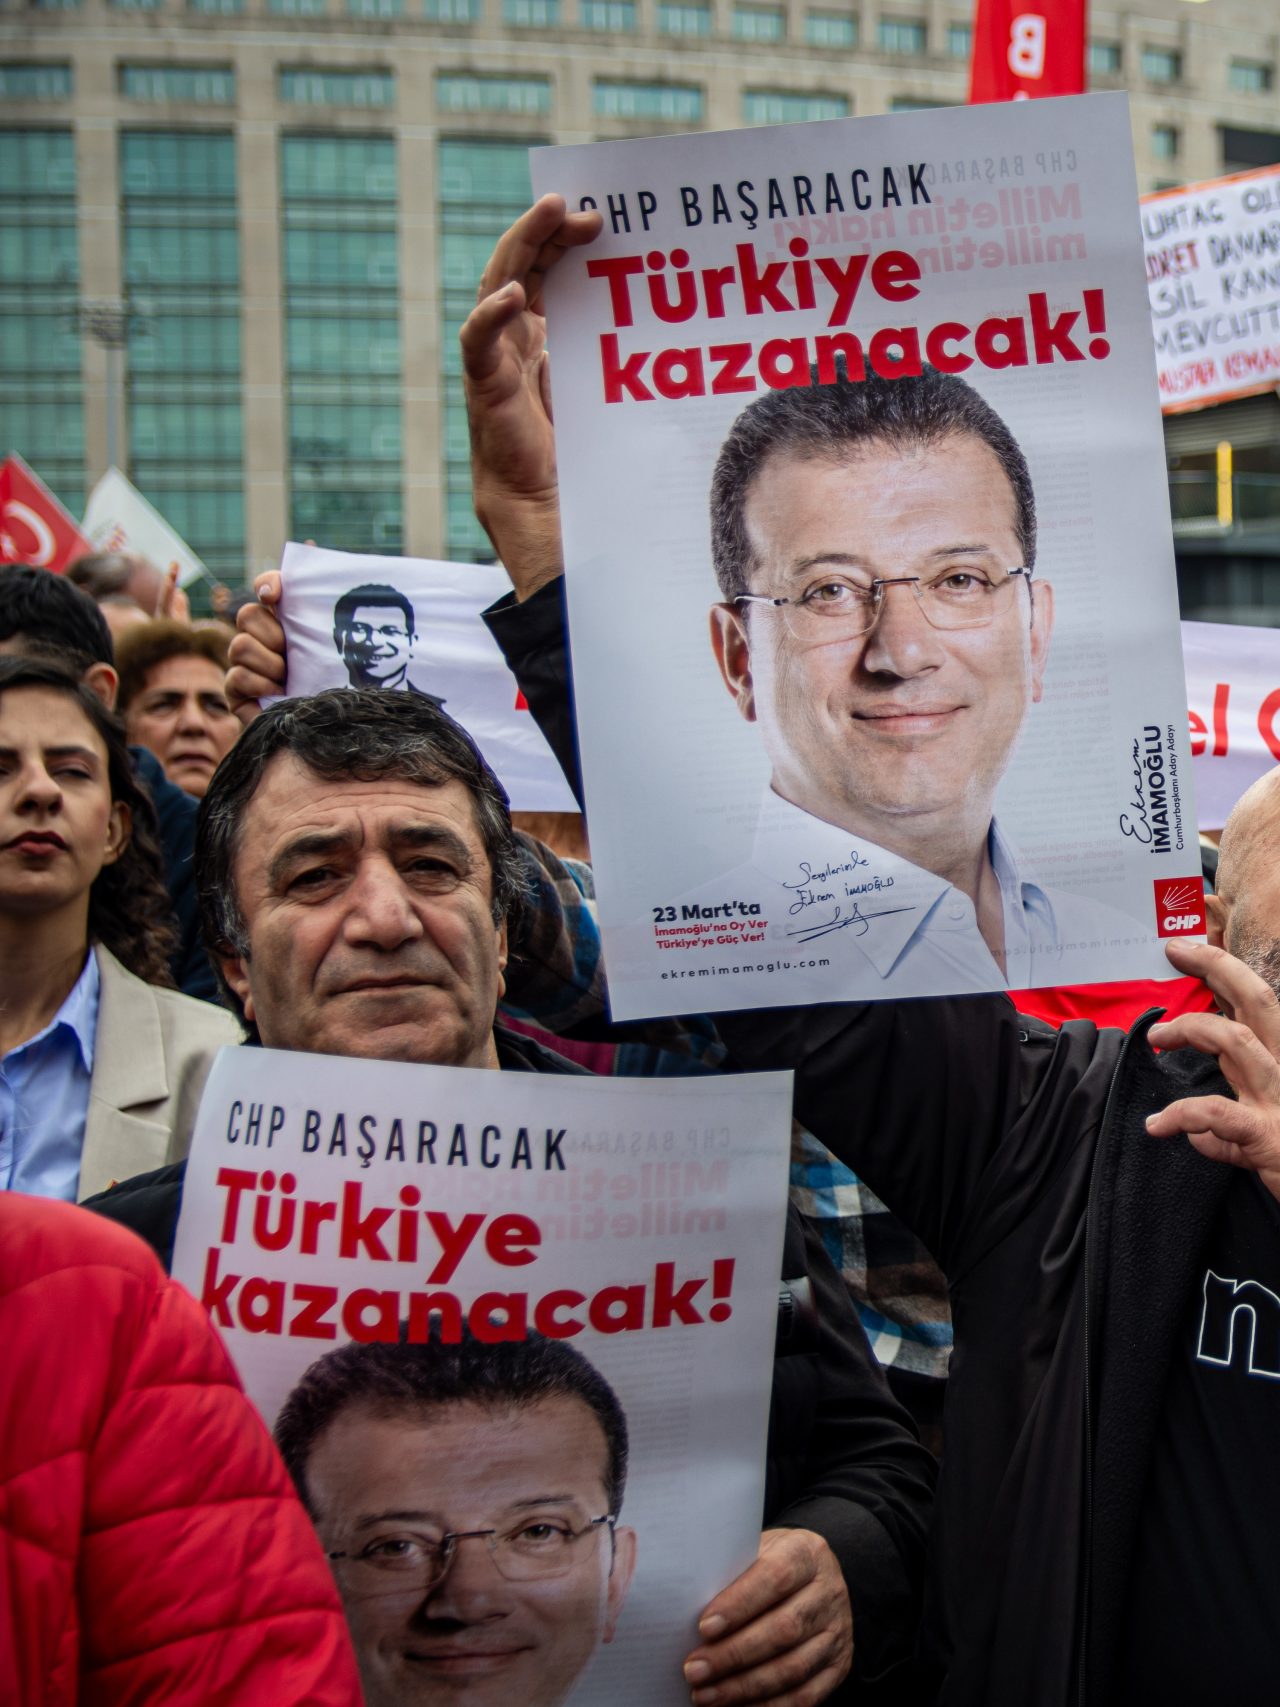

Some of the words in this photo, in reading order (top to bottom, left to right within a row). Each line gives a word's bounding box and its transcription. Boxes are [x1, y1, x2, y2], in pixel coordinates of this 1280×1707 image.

[681, 163, 932, 231] BAŞARACAK
[587, 237, 921, 329] Türkiye
[600, 288, 1110, 404] kazanacak!
[1166, 724, 1176, 749] Adayı
[1187, 683, 1230, 757] el
[1143, 725, 1172, 854] İMAMOĞLU
[1168, 753, 1178, 777] Aday
[1170, 778, 1185, 851] Cumhurbaşkanı
[652, 907, 677, 922] 23
[682, 901, 761, 921] Mart'ta
[654, 922, 727, 937] İmamoğlu'na
[730, 921, 746, 933] Oy
[748, 920, 768, 930] Ver
[656, 937, 715, 949] Türkiye'ye
[717, 935, 739, 946] Güç
[741, 932, 765, 943] Ver!
[1163, 914, 1201, 931] CHP
[661, 957, 830, 980] ekremimamoglu.com
[227, 1099, 286, 1149] CHP
[302, 1110, 568, 1170] BAŞARACAK
[215, 1168, 542, 1285] Türkiye
[203, 1248, 736, 1344] kazanacak!
